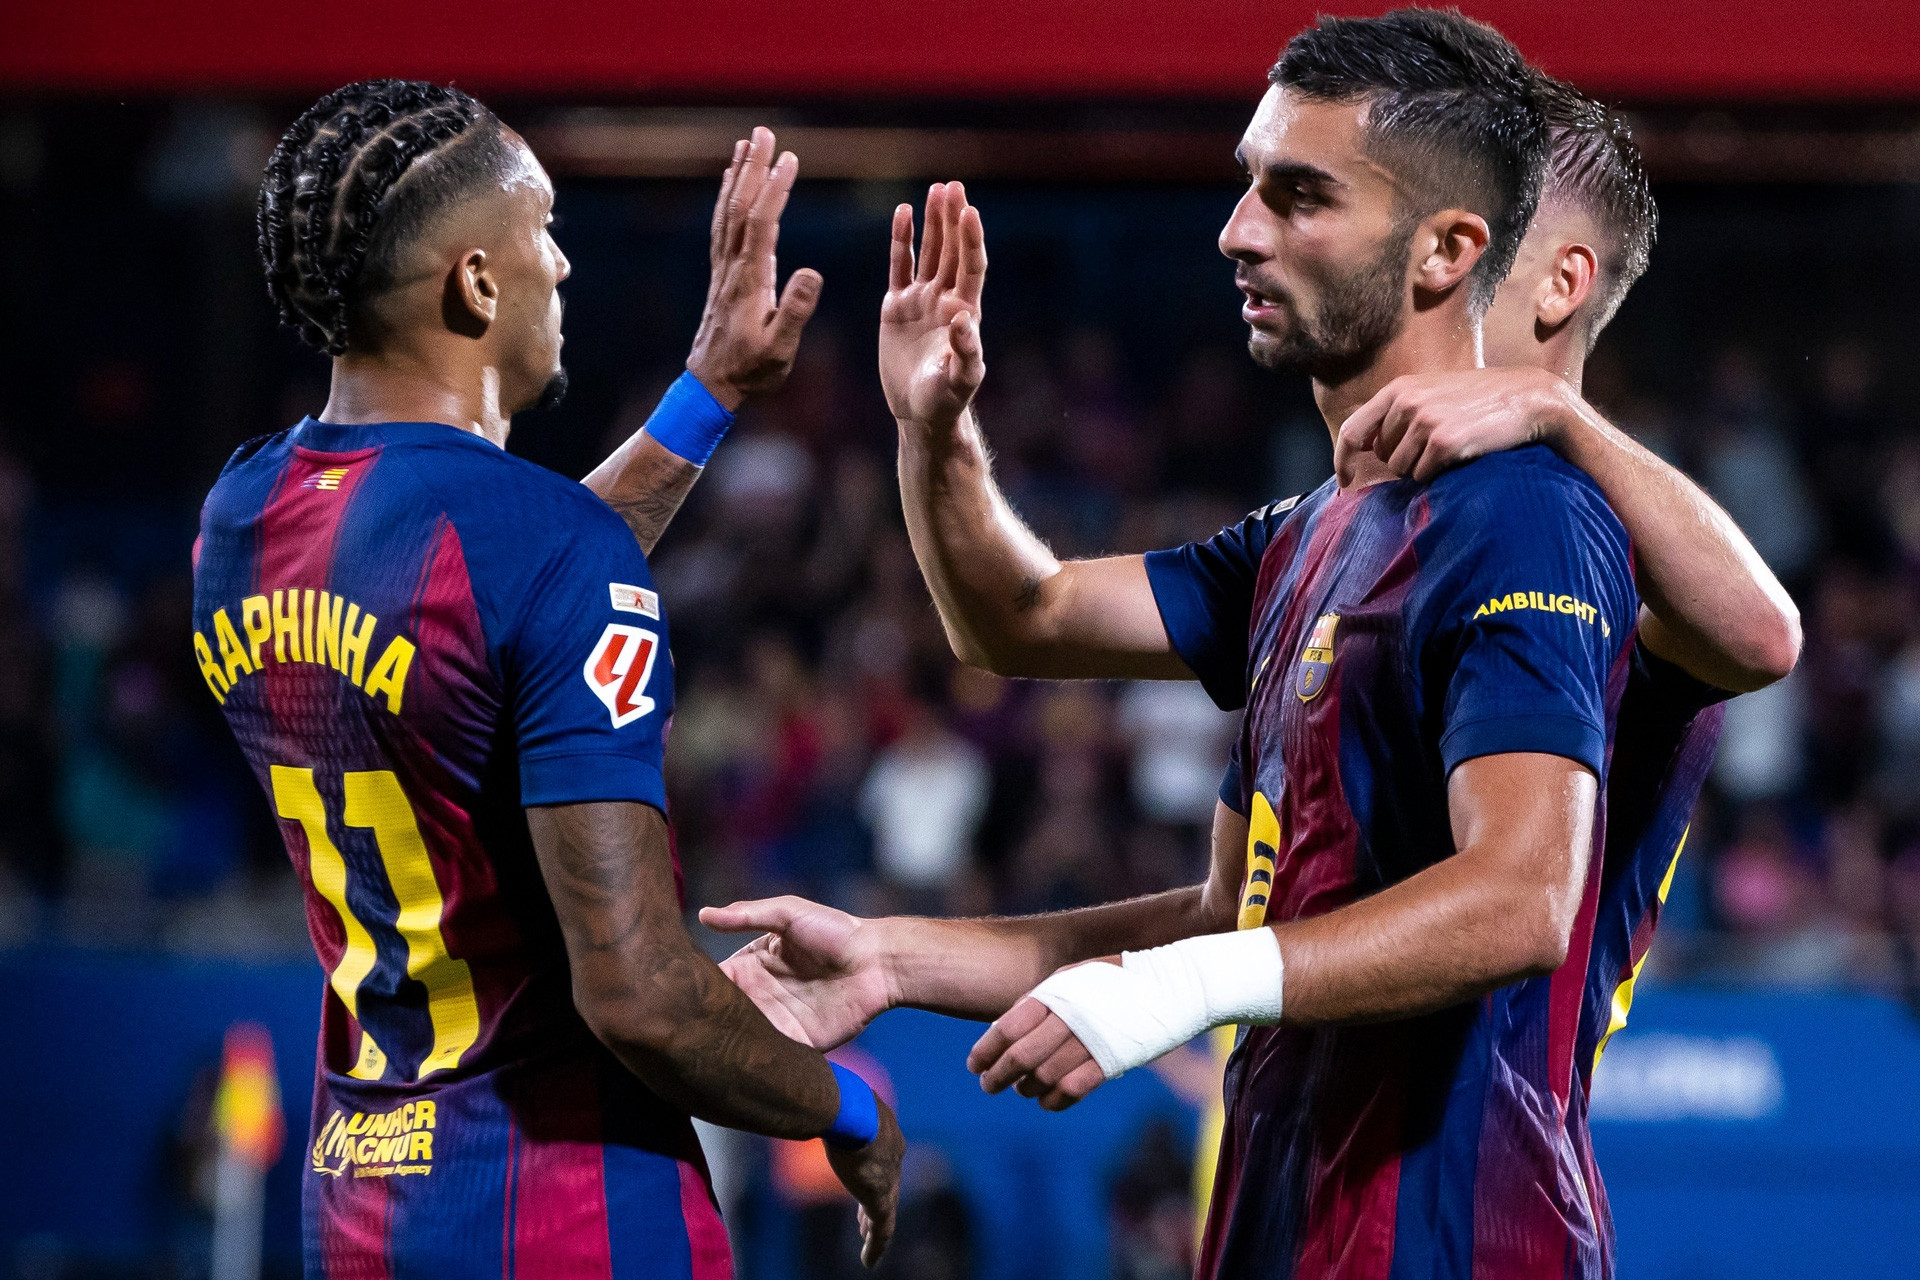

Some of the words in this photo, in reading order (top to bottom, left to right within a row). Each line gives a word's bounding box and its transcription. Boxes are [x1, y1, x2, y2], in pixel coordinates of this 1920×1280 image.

[1472, 591, 1598, 625] AMBILIGHT
[193, 588, 416, 716] RAPHINHA
[270, 764, 479, 1081] 11
[346, 1100, 437, 1137] UNHCR
[341, 1131, 434, 1165] ACNUR
